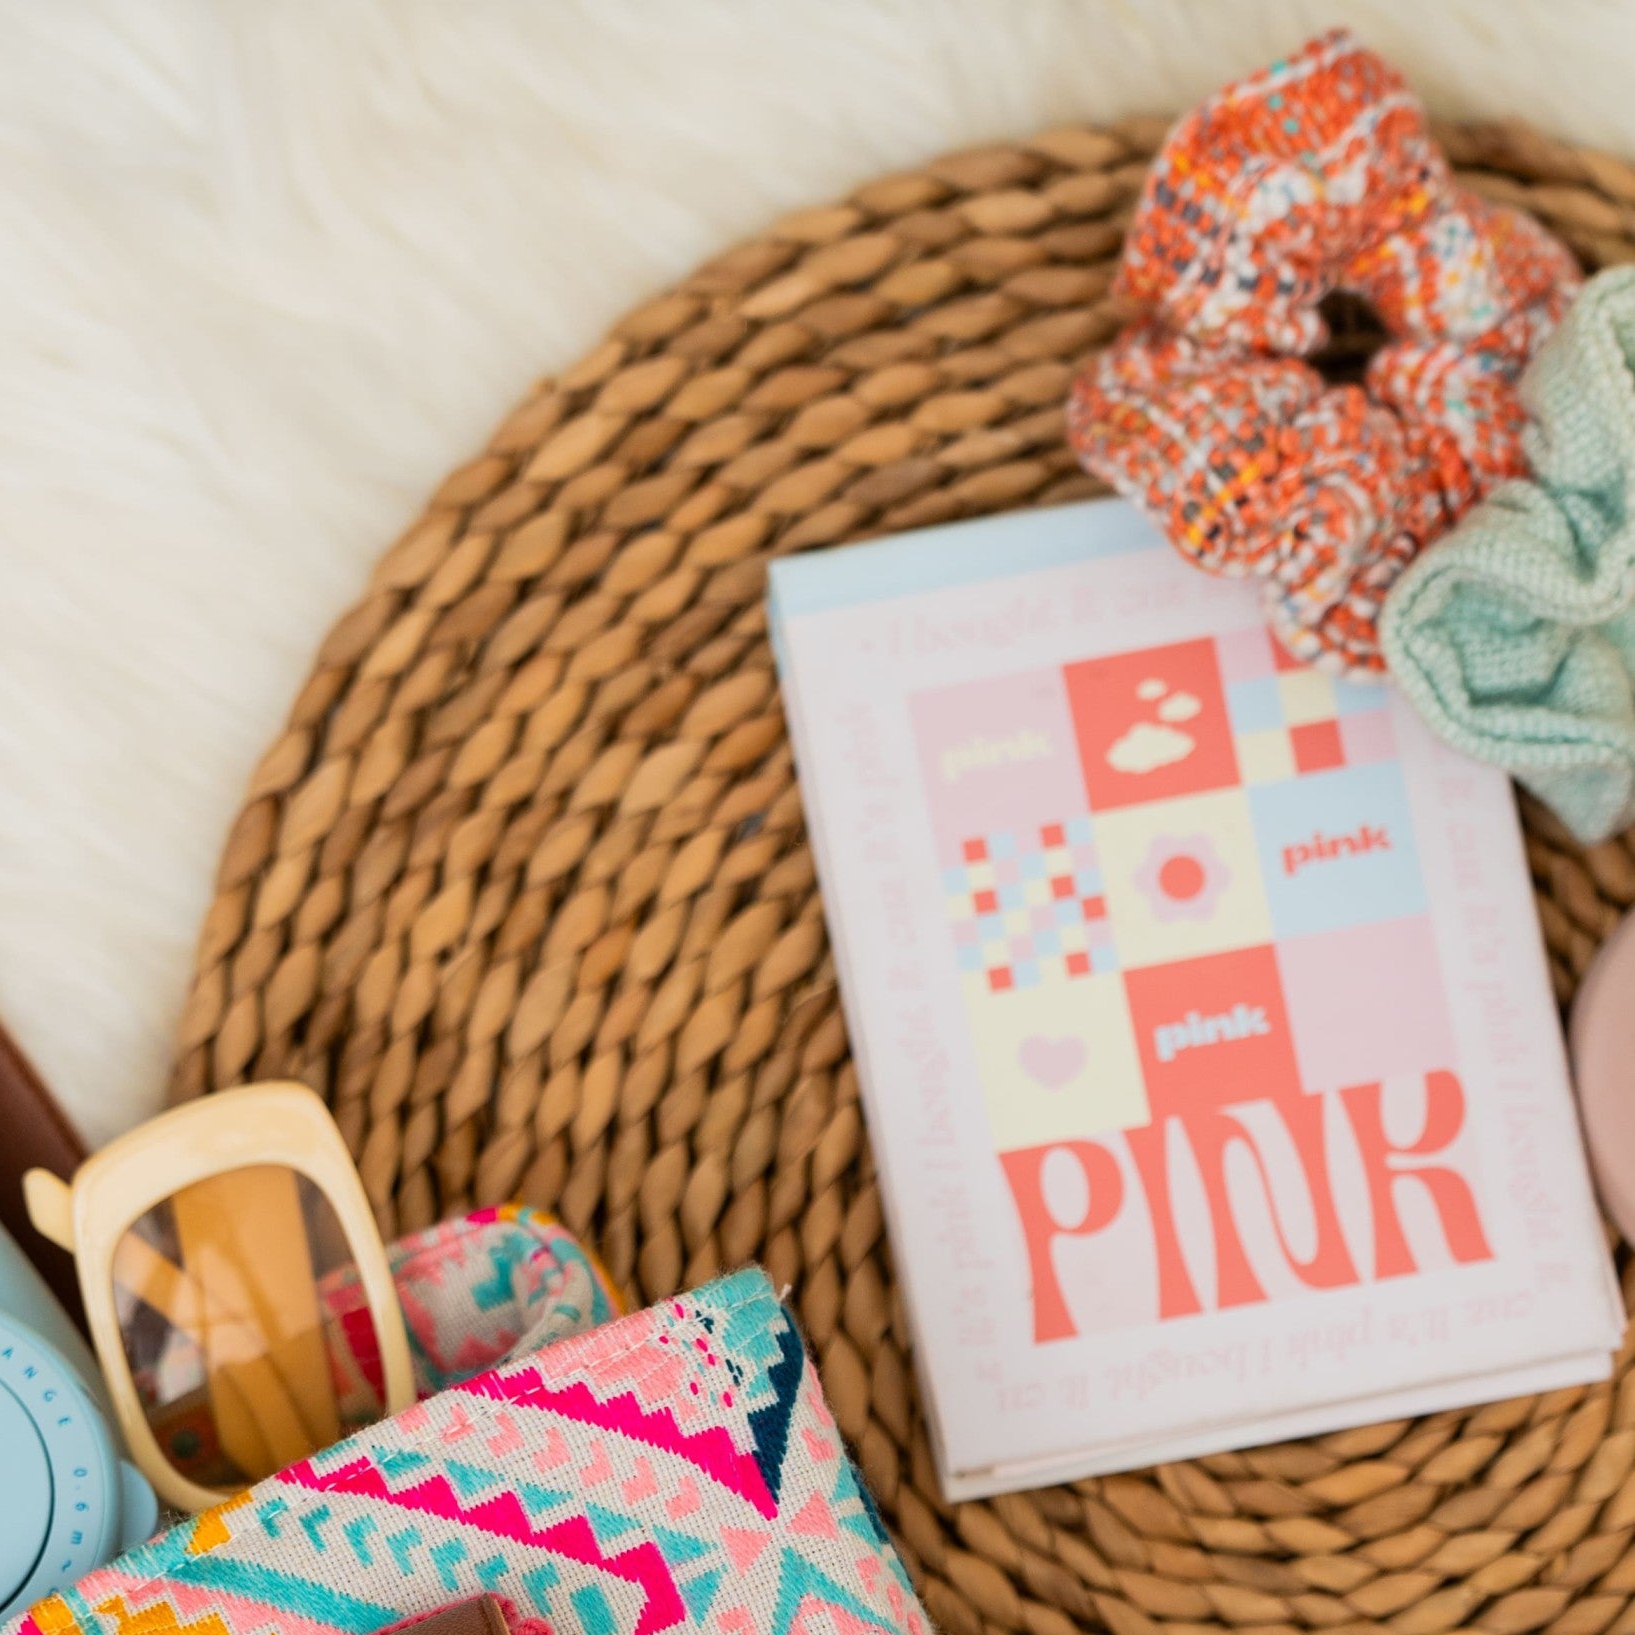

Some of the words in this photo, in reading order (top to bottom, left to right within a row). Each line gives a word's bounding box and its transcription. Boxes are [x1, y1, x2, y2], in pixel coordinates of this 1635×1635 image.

[939, 727, 1054, 781] pink
[1281, 823, 1393, 878] pink
[1154, 1001, 1273, 1062] pink
[998, 1069, 1497, 1345] PINK
[1286, 1308, 1375, 1372] pink
